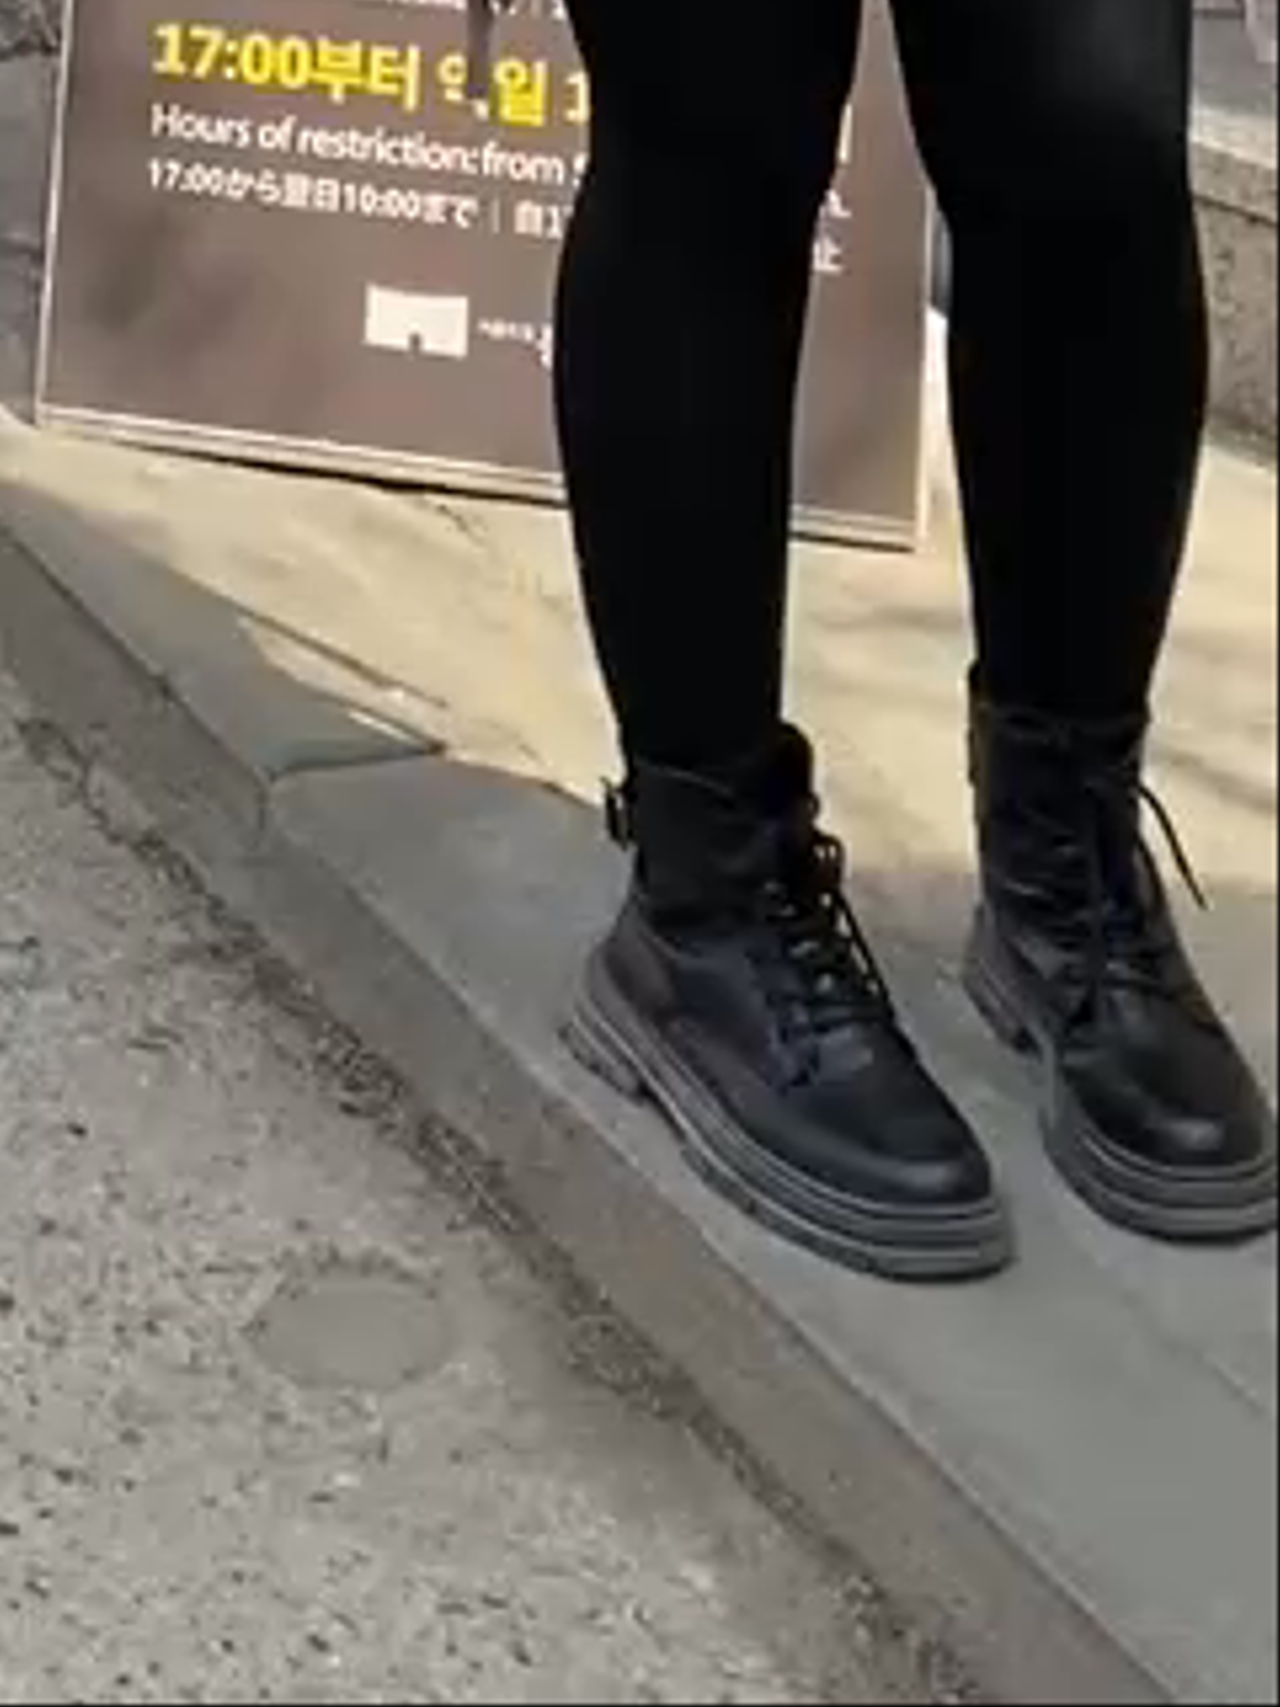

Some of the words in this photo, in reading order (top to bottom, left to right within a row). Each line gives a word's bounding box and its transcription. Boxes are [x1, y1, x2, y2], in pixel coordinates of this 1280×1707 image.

[151, 22, 421, 111] 17:00부터
[151, 103, 251, 147] Hours
[257, 114, 295, 154] of
